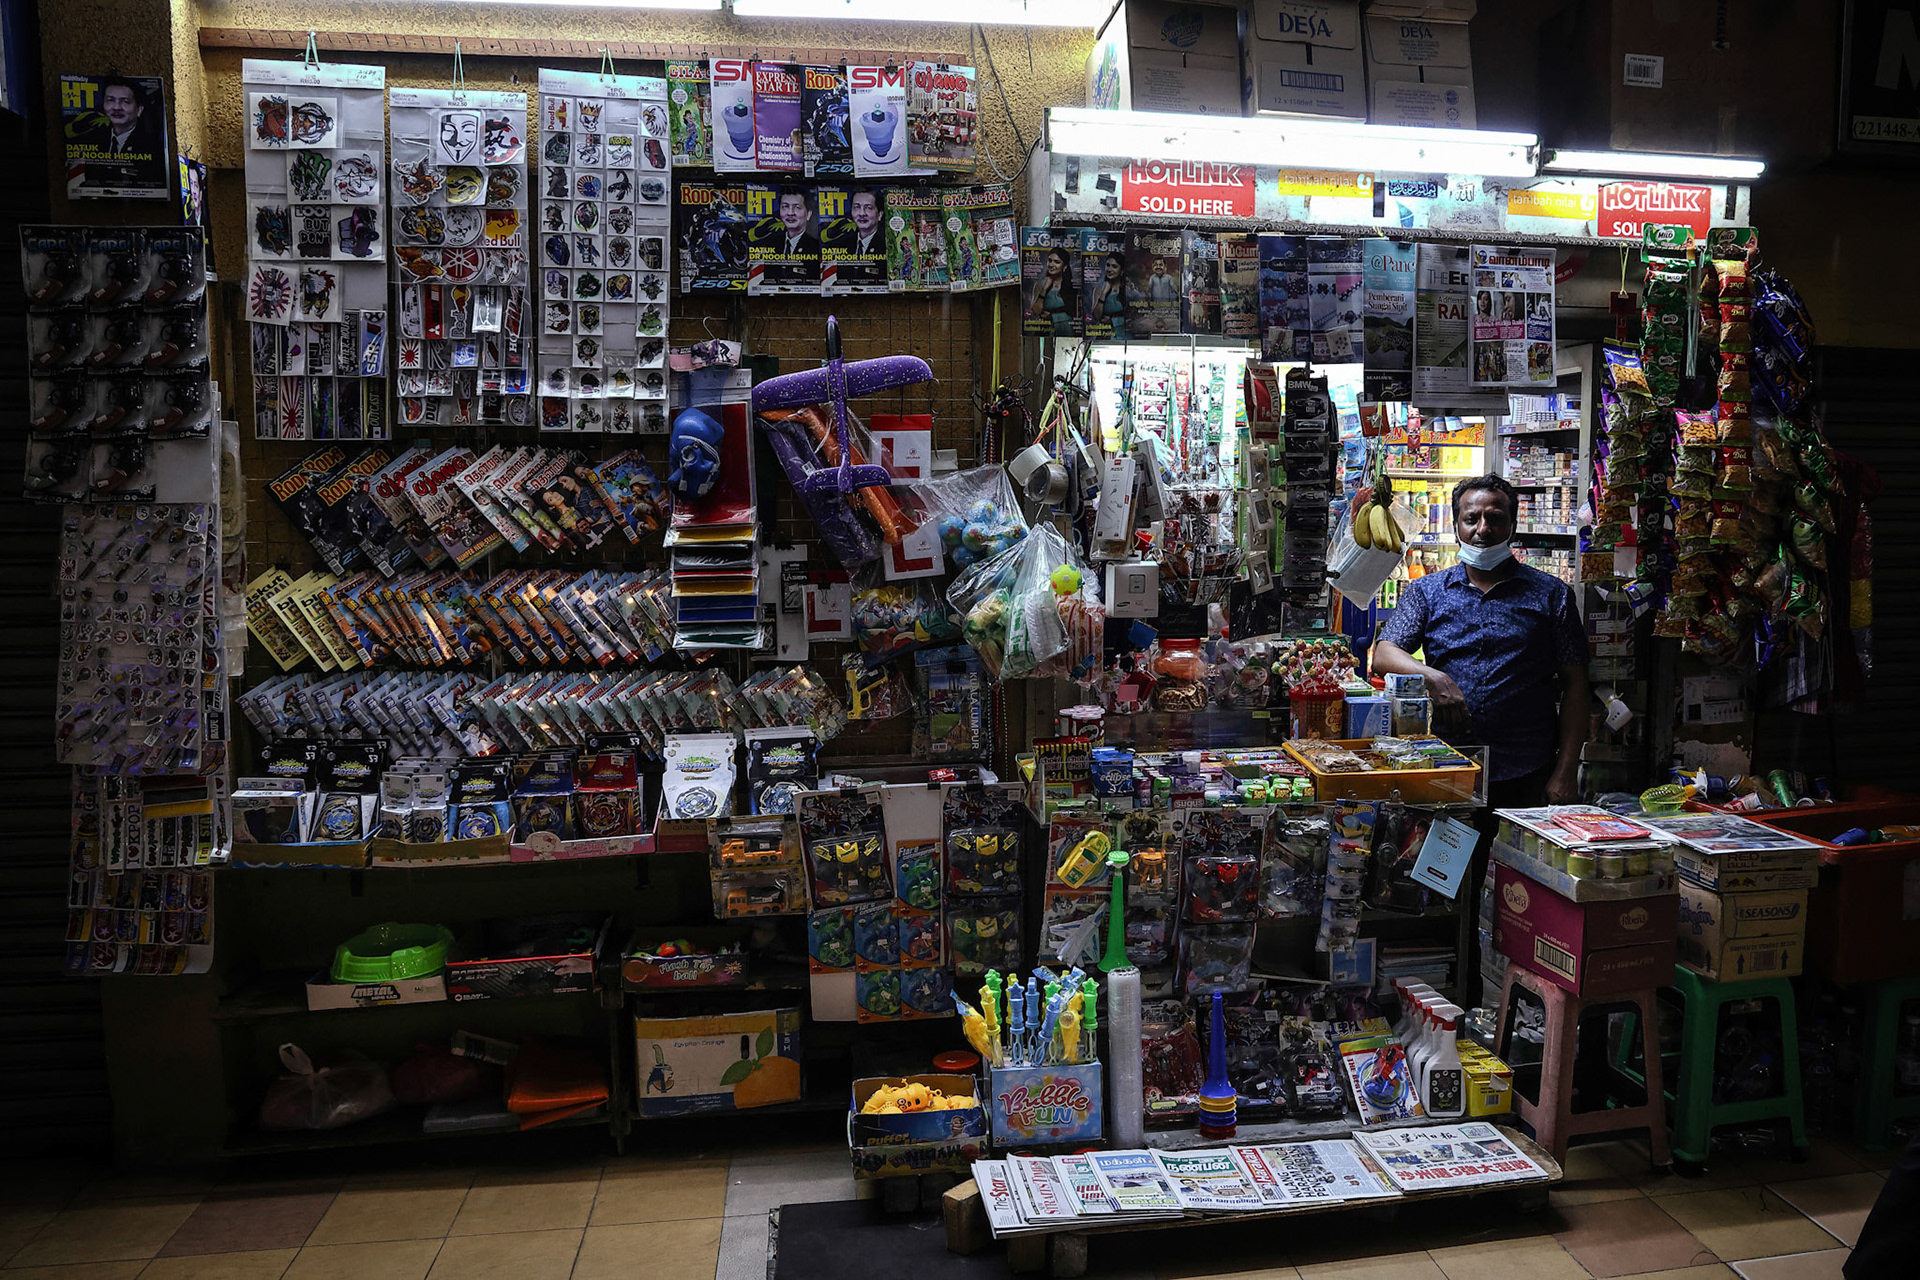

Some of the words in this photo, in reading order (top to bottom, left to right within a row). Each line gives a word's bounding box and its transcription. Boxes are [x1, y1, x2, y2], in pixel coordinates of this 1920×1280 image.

[1279, 12, 1333, 38] DESA
[1400, 24, 1434, 39] DESA
[755, 71, 797, 84] EXPRESS
[61, 81, 99, 109] HT
[754, 82, 785, 93] STAR
[758, 135, 782, 145] Chemistry
[66, 144, 99, 152] DATUK
[113, 152, 153, 161] HISHAM
[757, 151, 792, 161] Relationships
[1283, 172, 1328, 186] tambah
[1329, 173, 1354, 187] nilai
[721, 187, 747, 205] ROD
[747, 190, 777, 215] HT
[818, 191, 848, 216] HT
[942, 189, 1009, 208] GILA-GILA
[1512, 192, 1553, 206] tambah
[1554, 196, 1578, 208] nilai
[1139, 196, 1186, 212] SOLD
[1189, 198, 1234, 216] HERE
[306, 219, 329, 229] BUT
[1612, 220, 1643, 237] SOL
[500, 234, 521, 247] Bull
[1657, 230, 1674, 241] MILO
[749, 246, 776, 254] DATUK
[761, 253, 785, 261] NOOR
[787, 253, 818, 261] HISHAM
[821, 247, 848, 255] DATUK
[1368, 292, 1405, 302] Pemberani
[1368, 302, 1390, 312] Sungai
[1287, 380, 1311, 390] BMW
[369, 392, 380, 427] OUTCAST
[615, 580, 641, 598] LAWAK
[806, 591, 842, 634] L
[968, 671, 979, 704] KUALA
[970, 703, 981, 750] LUMPUR
[1381, 704, 1390, 737] MYDIN
[675, 762, 722, 771] BEYBLADE
[762, 755, 805, 764] BEYBLADE
[1100, 770, 1133, 785] eclipse
[128, 804, 141, 846] KPOP
[1727, 851, 1760, 862] RED
[1505, 887, 1527, 909] Ribena
[1621, 912, 1646, 926] Ribena
[1745, 905, 1791, 919] SEASONS
[999, 1083, 1091, 1115] Bubble
[1020, 1106, 1074, 1127] FUN
